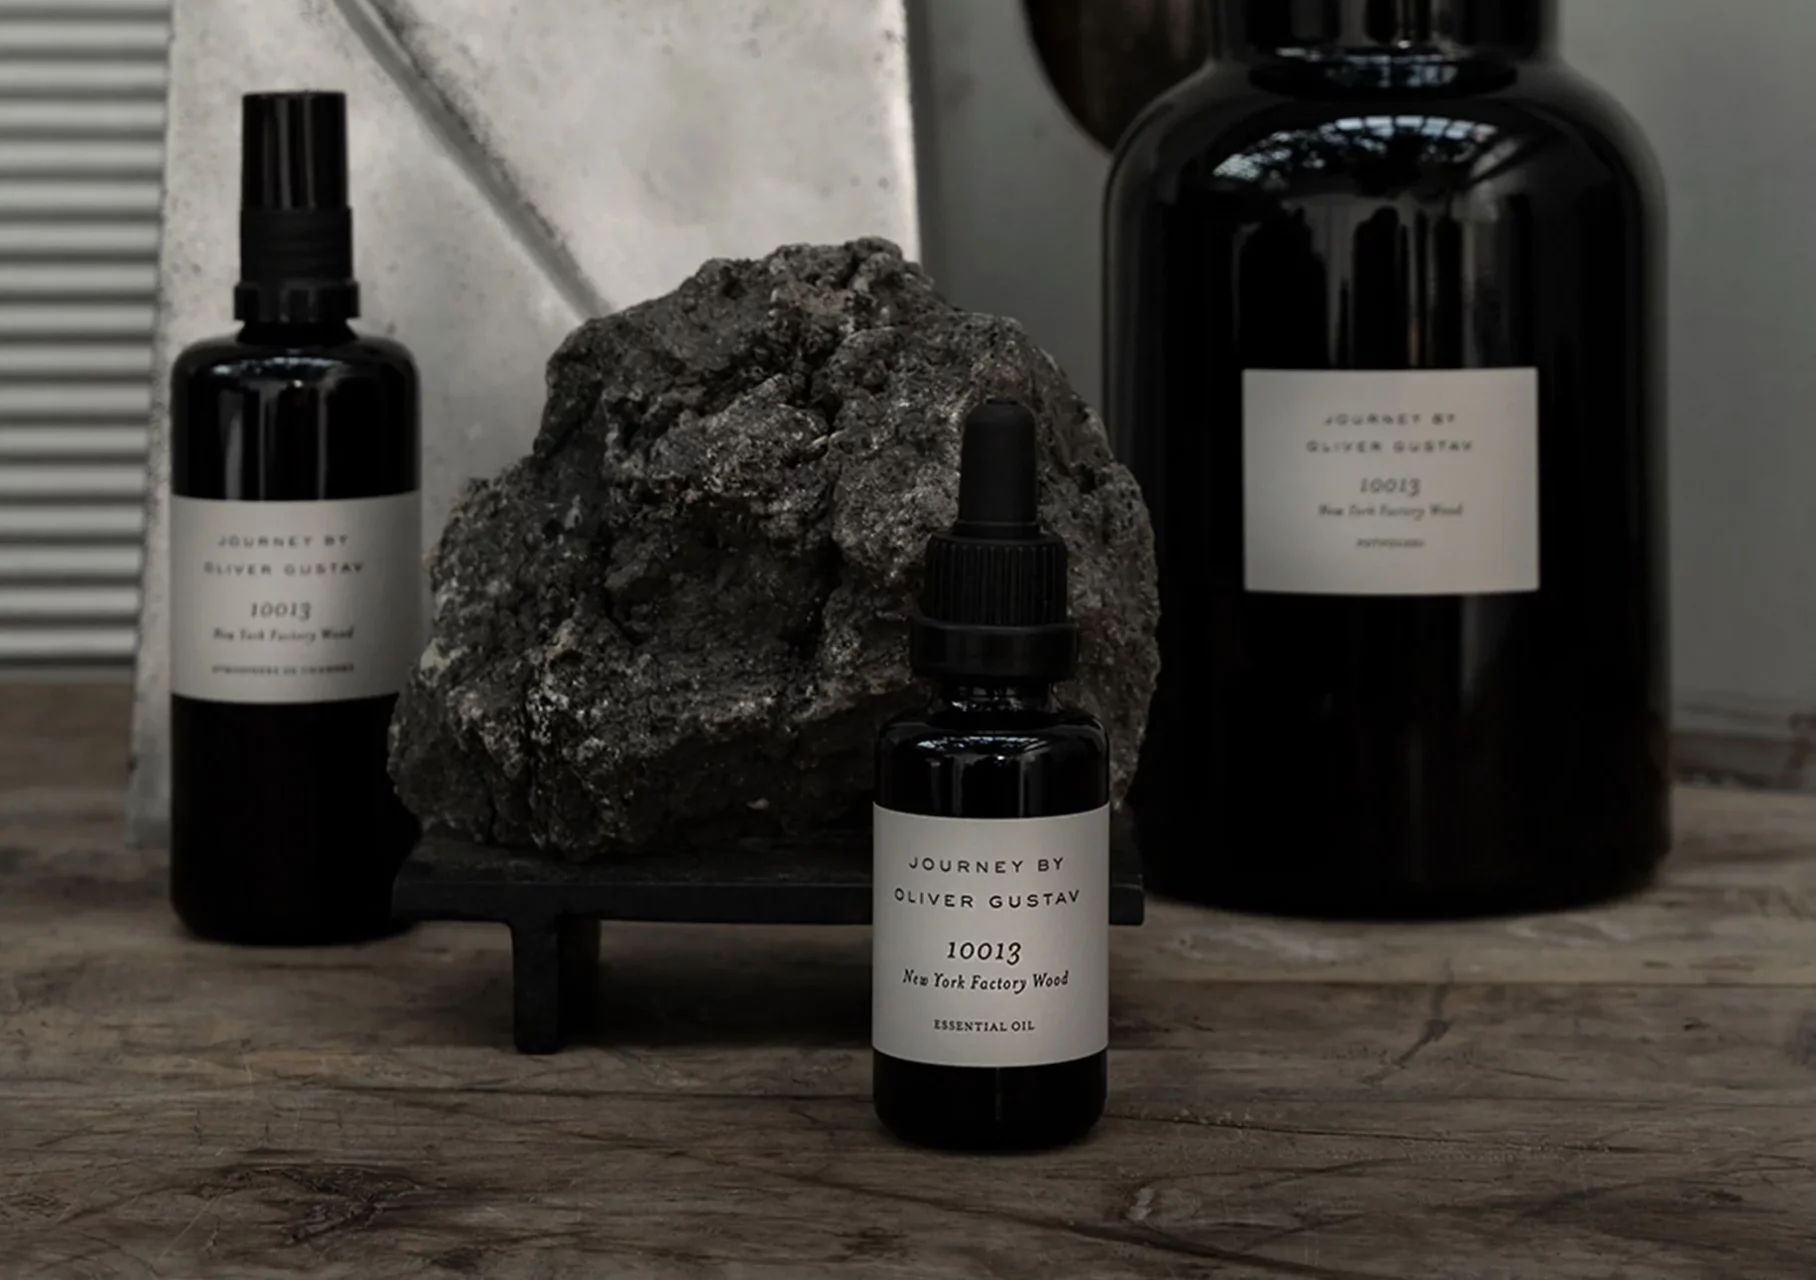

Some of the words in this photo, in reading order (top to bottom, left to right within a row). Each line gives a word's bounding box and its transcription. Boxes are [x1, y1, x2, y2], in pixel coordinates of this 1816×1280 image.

[1359, 477, 1422, 497] 10013
[250, 600, 312, 622] 10013
[908, 856, 1024, 874] JOURNEY
[1037, 857, 1064, 872] BY
[893, 887, 974, 908] OLIVER
[988, 889, 1080, 909] GUSTAV
[946, 941, 1022, 966] 10013
[902, 968, 929, 987] New
[933, 972, 965, 990] York
[970, 974, 1027, 995] Factory
[1032, 970, 1069, 989] Wood
[933, 1019, 1008, 1032] ESSENTIAL
[1011, 1020, 1035, 1032] OIL
